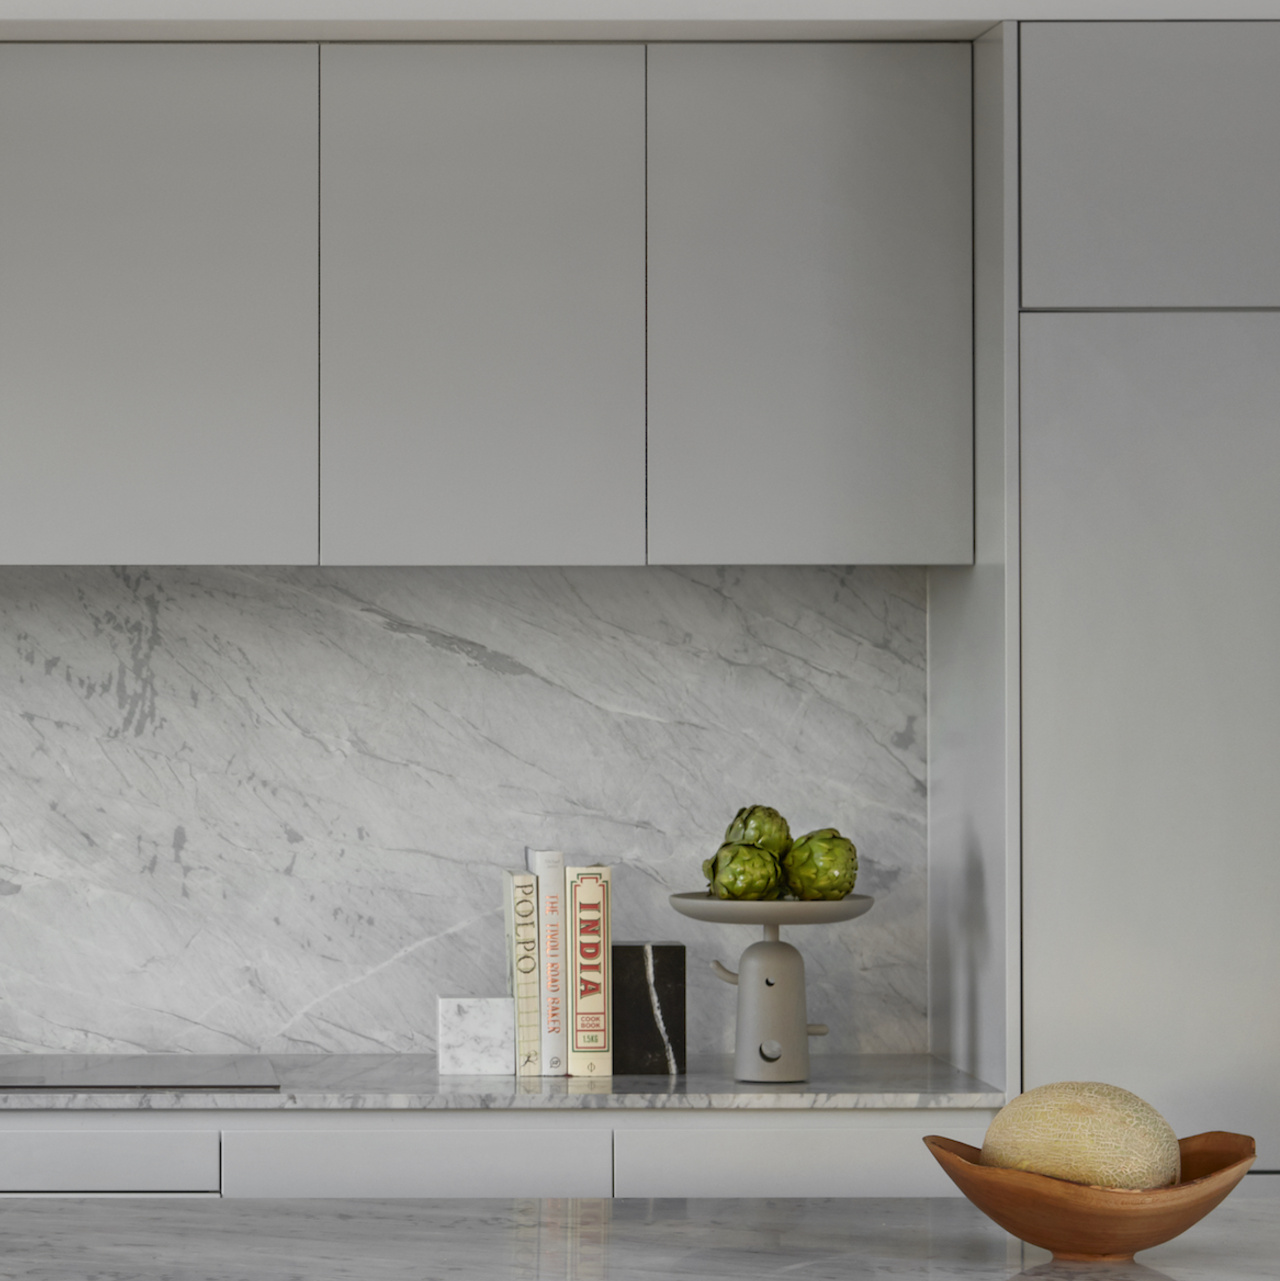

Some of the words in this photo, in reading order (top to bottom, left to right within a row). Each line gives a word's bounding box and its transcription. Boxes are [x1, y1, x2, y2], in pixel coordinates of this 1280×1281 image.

[545, 894, 559, 916] THE
[515, 883, 536, 974] POLPO
[545, 922, 560, 957] TIVOLI
[579, 901, 601, 1000] INDIA
[546, 962, 561, 993] ROAD
[547, 997, 561, 1034] BAKER
